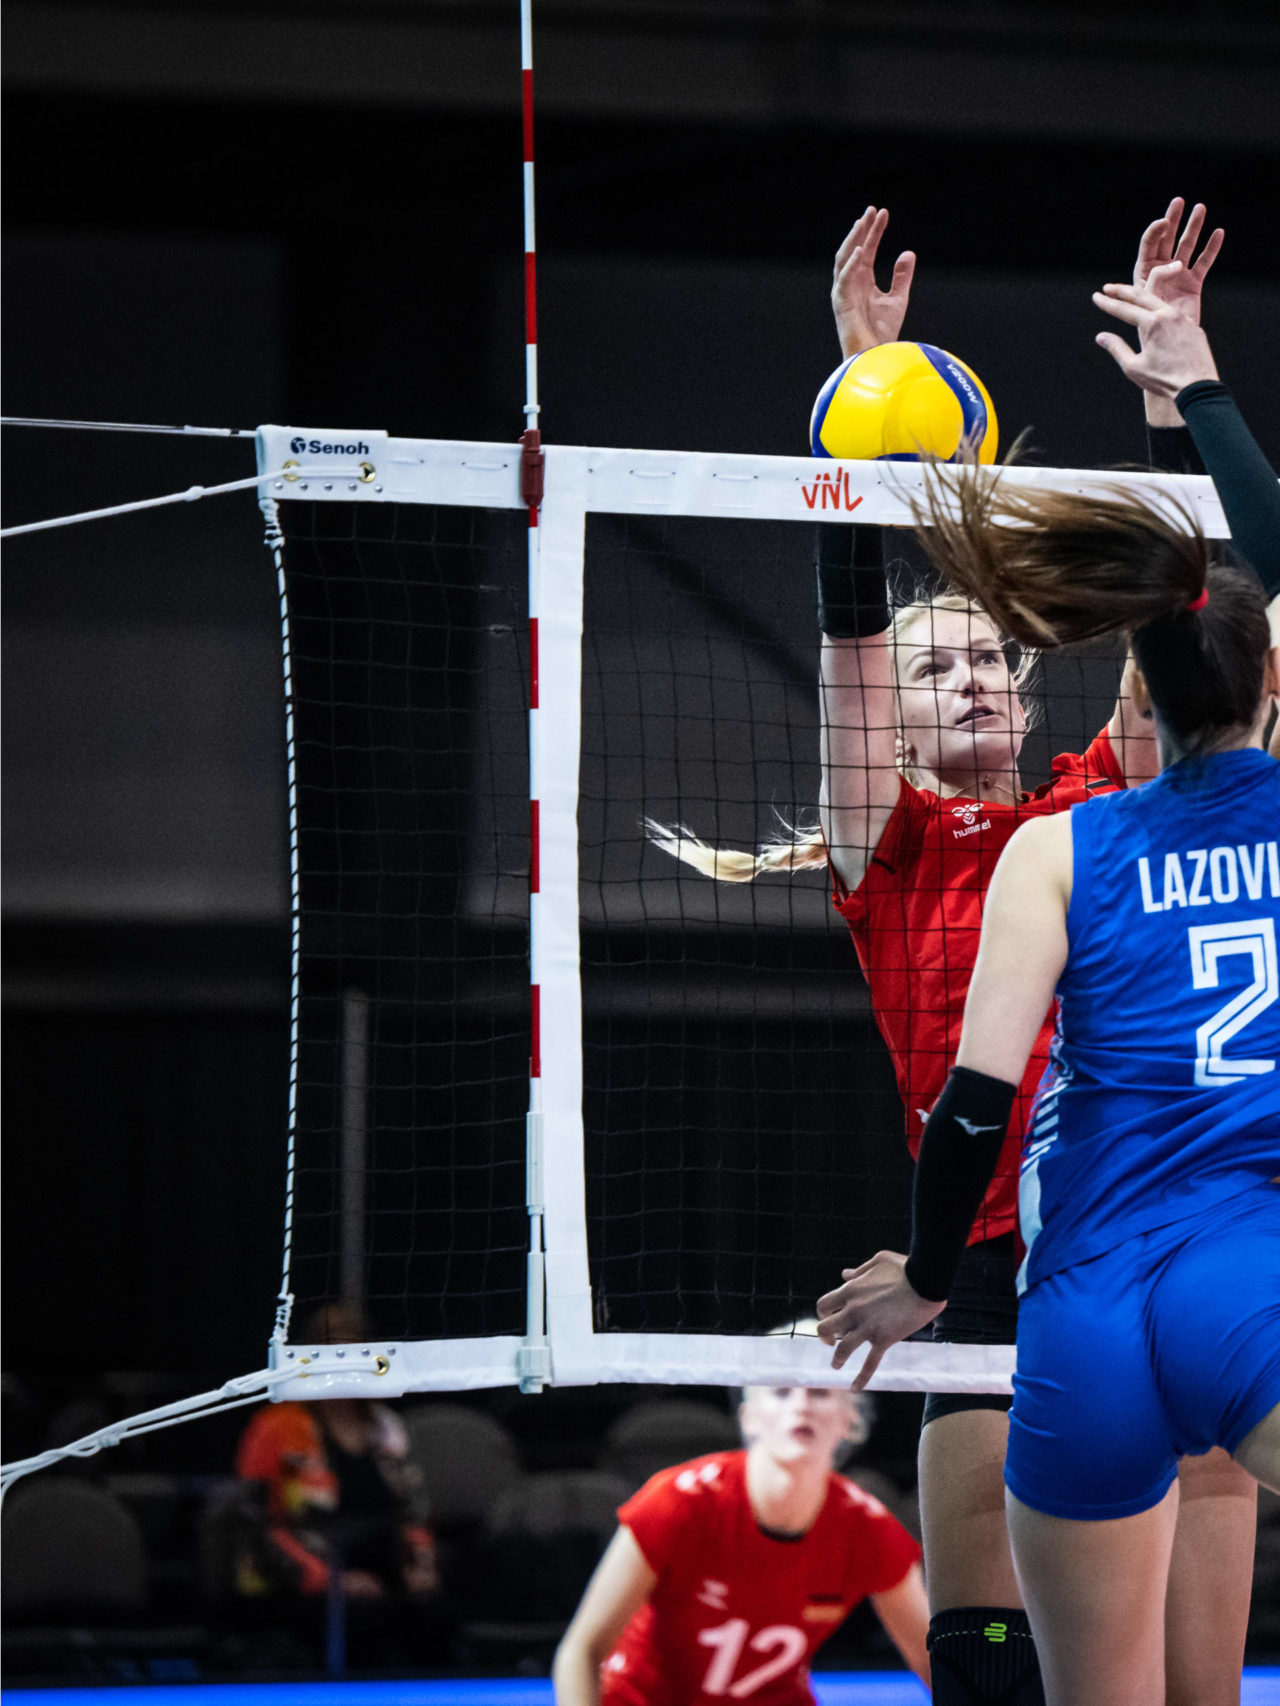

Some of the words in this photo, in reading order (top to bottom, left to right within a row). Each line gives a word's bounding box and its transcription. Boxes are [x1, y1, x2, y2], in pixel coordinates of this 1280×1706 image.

[947, 363, 978, 404] V200W
[308, 440, 369, 455] Senoh
[801, 466, 864, 512] VNL
[952, 818, 992, 840] hummel
[1188, 917, 1280, 1087] 2
[697, 1617, 809, 1698] 12
